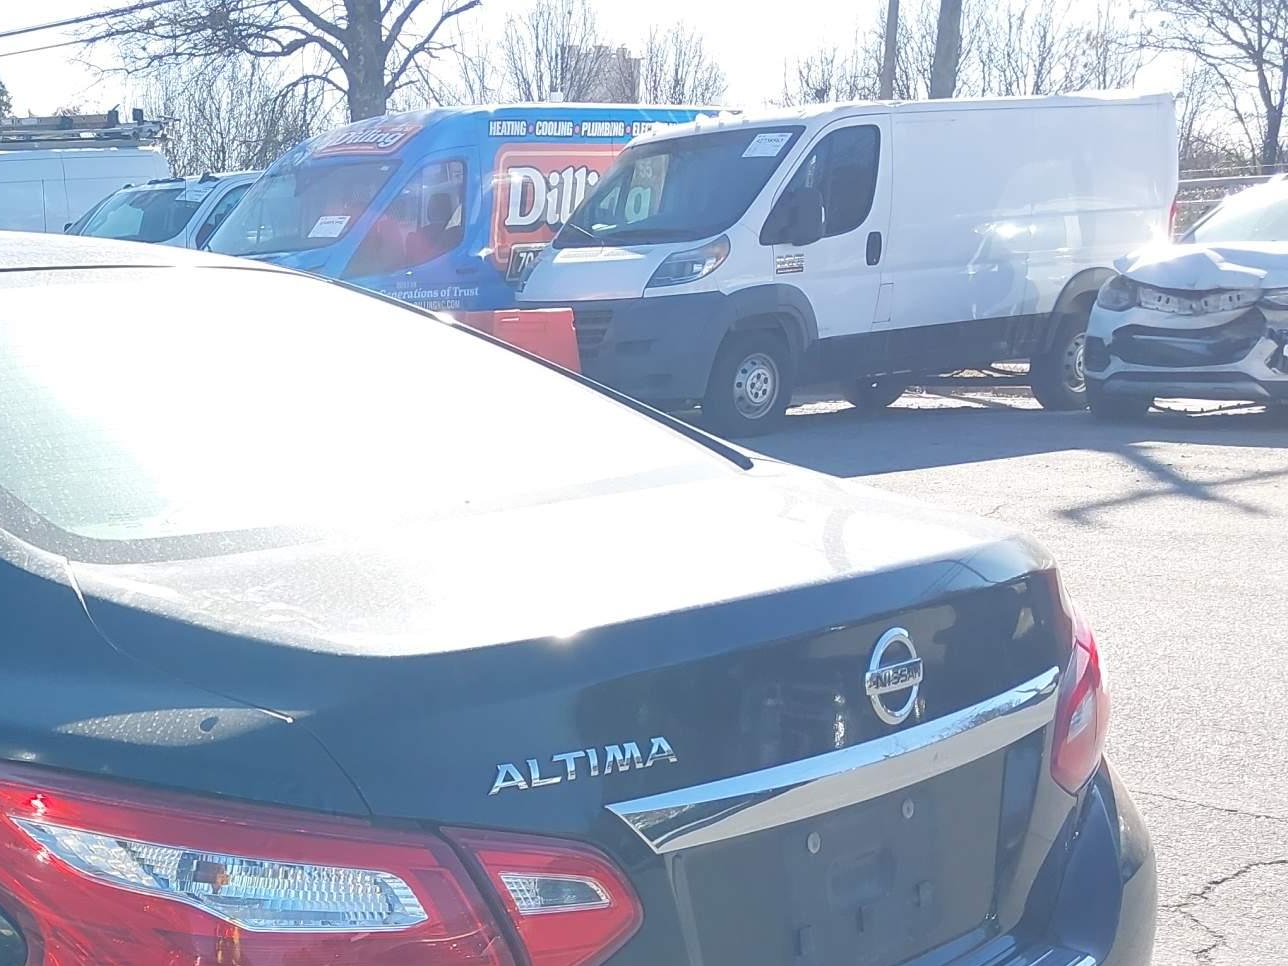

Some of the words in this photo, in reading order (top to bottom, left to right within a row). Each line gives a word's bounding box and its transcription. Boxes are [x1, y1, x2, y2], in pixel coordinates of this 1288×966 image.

[489, 120, 526, 136] HEATING
[535, 121, 573, 137] COOLING
[581, 121, 625, 137] PLUMBING
[440, 286, 451, 298] of
[452, 286, 479, 297] Trust
[874, 667, 920, 689] NISSAN
[487, 736, 678, 796] ALTIMA
